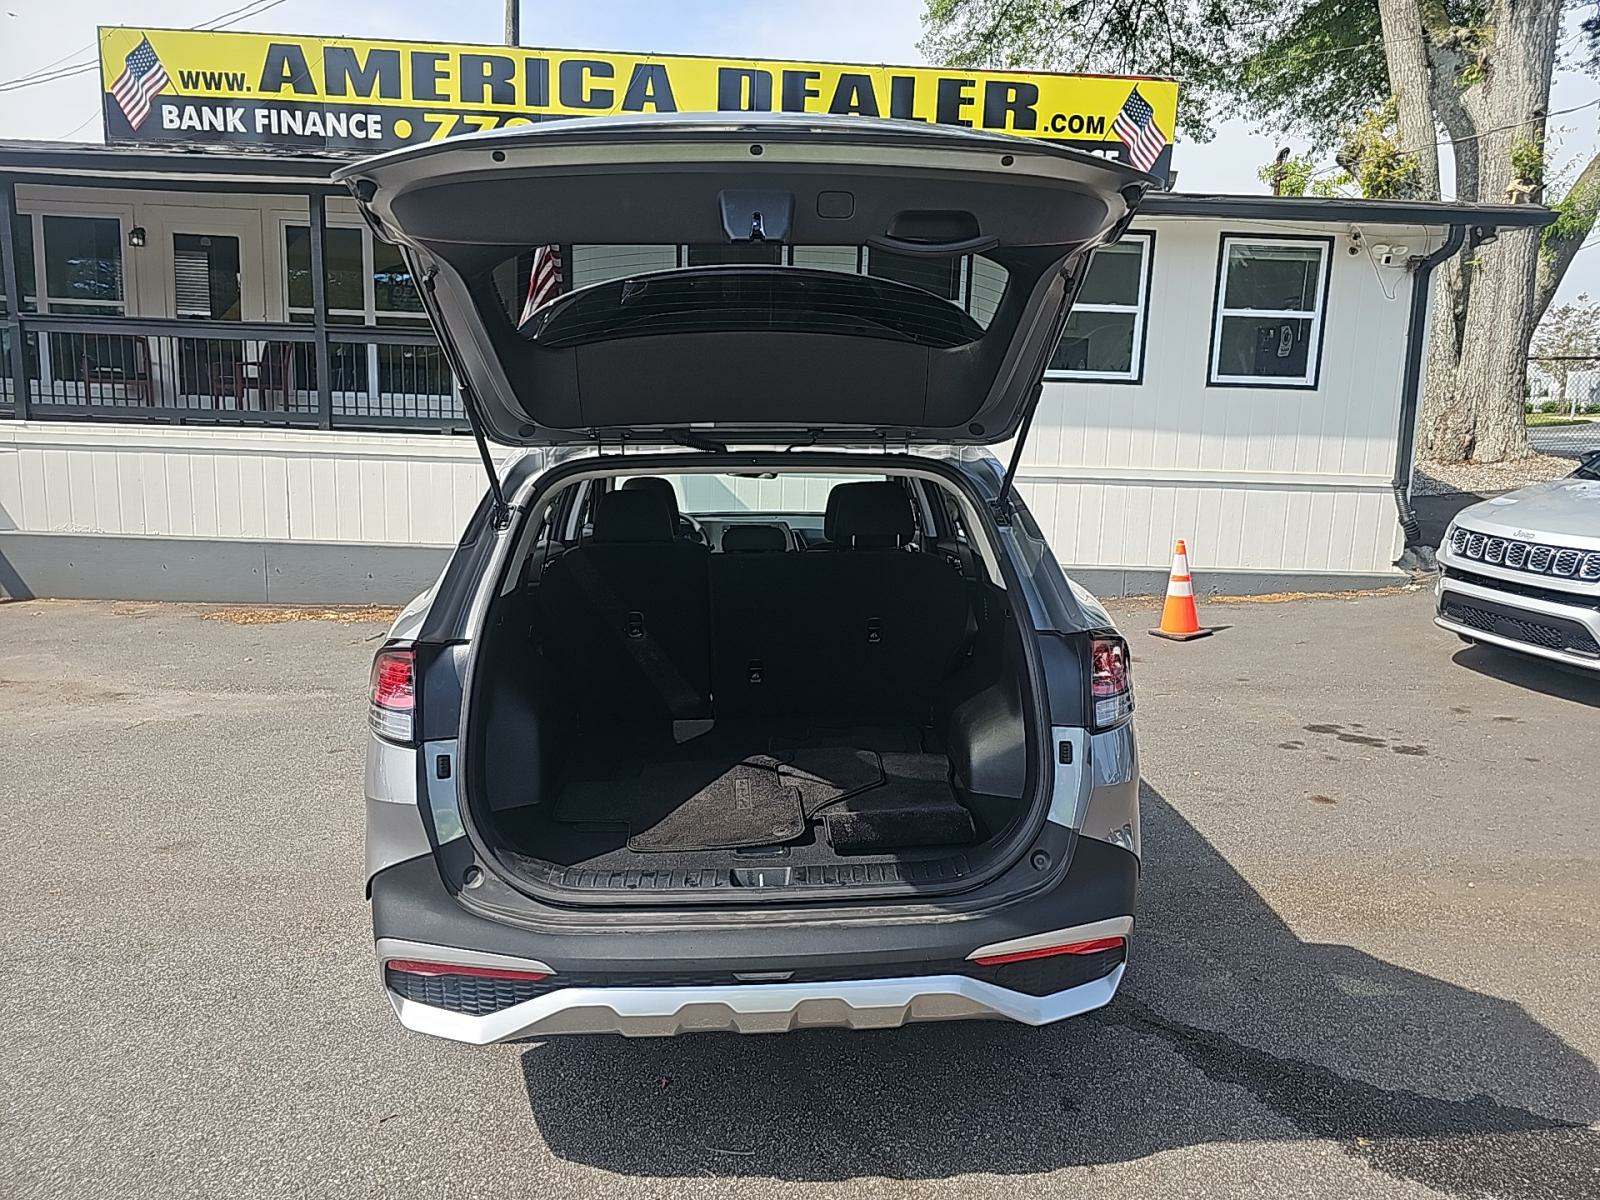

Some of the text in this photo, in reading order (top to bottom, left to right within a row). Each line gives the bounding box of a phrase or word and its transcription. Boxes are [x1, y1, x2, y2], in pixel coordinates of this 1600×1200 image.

[178, 43, 1105, 135] www. AMERICA DEALER .COM
[162, 104, 247, 133] BANK
[255, 108, 382, 139] FINANCE
